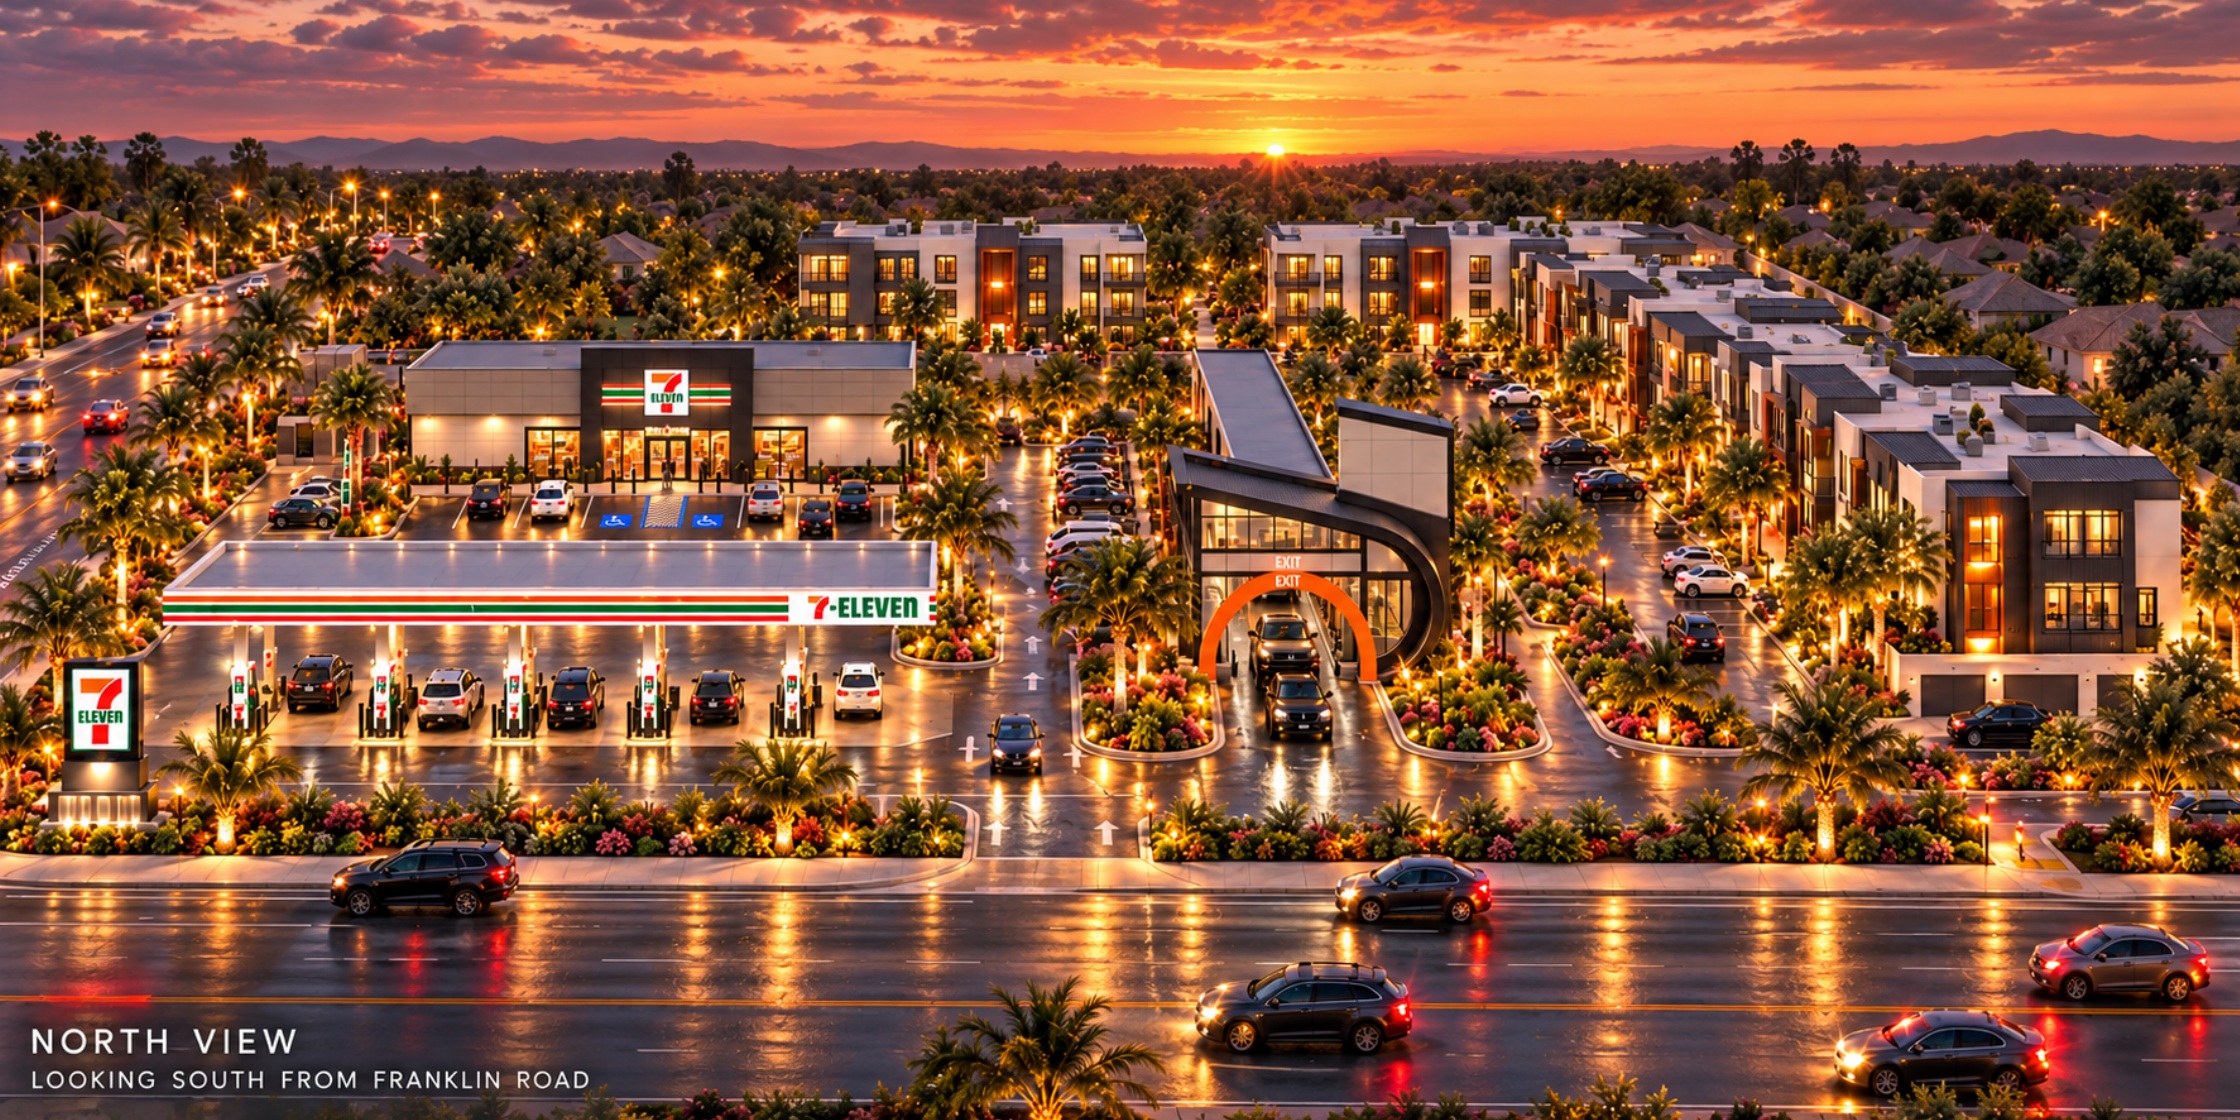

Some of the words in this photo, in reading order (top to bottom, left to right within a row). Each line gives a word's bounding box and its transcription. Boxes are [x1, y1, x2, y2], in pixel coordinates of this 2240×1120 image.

[651, 373, 683, 414] 7
[1275, 556, 1301, 569] EXIT
[1275, 574, 1300, 588] EXIT
[80, 677, 122, 745] 7
